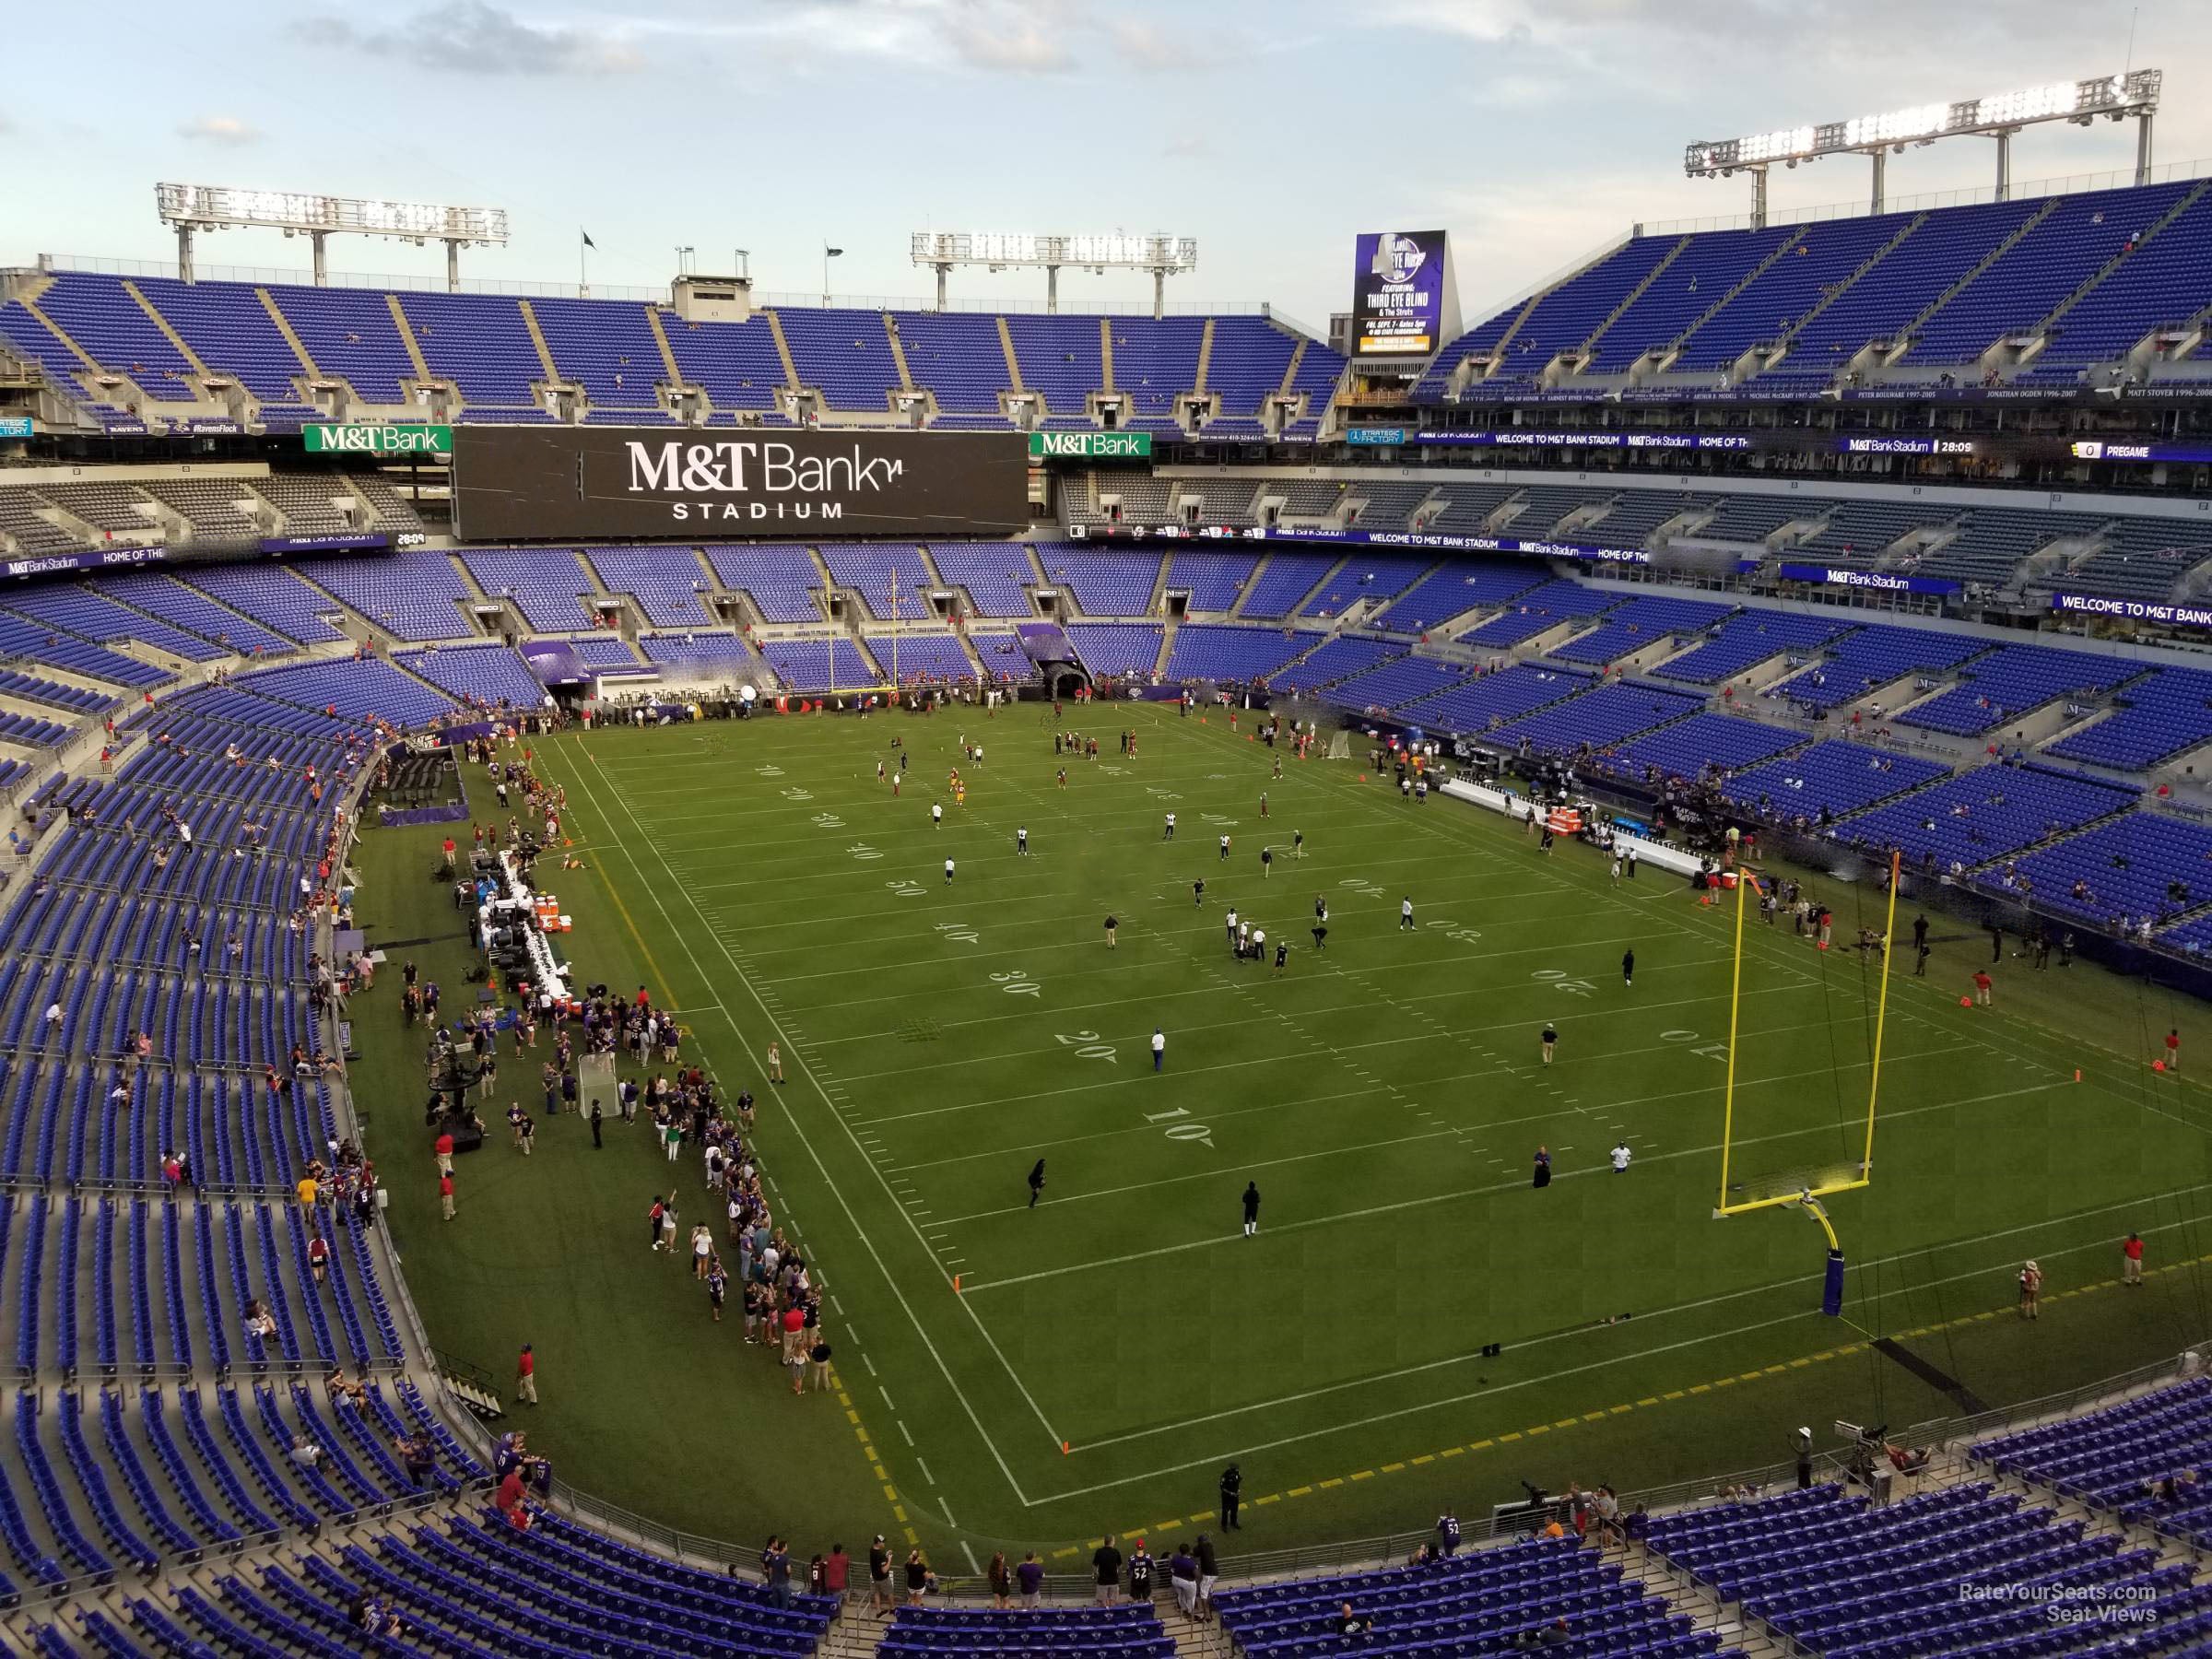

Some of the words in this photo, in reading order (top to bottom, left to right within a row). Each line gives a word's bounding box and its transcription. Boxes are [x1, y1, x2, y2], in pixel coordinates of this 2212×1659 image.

[1367, 294, 1389, 309] THIRD
[1391, 293, 1404, 308] EYE
[1406, 292, 1429, 307] BLIND
[1986, 390, 2018, 398] JONATHAN
[193, 424, 238, 434] #RavensFlock
[319, 427, 381, 450] M&T
[383, 427, 439, 450] Bank
[1041, 434, 1092, 454] M&T
[1093, 434, 1139, 454] Bank
[1495, 434, 1534, 443] WELCOME
[1535, 435, 1547, 443] TO
[1547, 435, 1565, 443] M&T
[1566, 435, 1587, 444] BANK
[1588, 435, 1619, 444] STADIUM
[1628, 436, 1645, 445] M&T
[1645, 436, 1662, 445] Bank
[1663, 436, 1690, 446] Stadium
[1699, 438, 1723, 446] HOME
[1724, 438, 1736, 447] OF
[1850, 440, 1872, 451] M&T
[1872, 440, 1894, 451] Bank
[1893, 441, 1928, 452] Stadium
[1941, 442, 1971, 452] 28:09
[2087, 445, 2094, 456] 0
[2107, 446, 2149, 457] PREGAME
[625, 441, 757, 491] M&T
[764, 443, 880, 491] Bank
[673, 502, 842, 520] STADIUM
[398, 534, 425, 545] 28:09
[1369, 534, 1408, 544] WELCOME
[1411, 535, 1423, 544] TO
[1424, 536, 1441, 545] M&T
[1443, 537, 1464, 547] BANK
[1465, 538, 1499, 548] STADIUM
[103, 550, 130, 563] HOME
[132, 548, 146, 559] OF
[1519, 542, 1536, 552] M&T
[1535, 543, 1552, 554] Bank
[1552, 544, 1579, 557] Stadium
[1598, 548, 1620, 559] HOME
[1621, 550, 1633, 560] OF
[8, 561, 29, 574] M&T
[29, 560, 48, 572] Bank
[48, 557, 78, 570] Stadium
[1827, 570, 1850, 583] M&T
[1850, 572, 1871, 586] Bank
[1872, 574, 1909, 589] Stadium
[2062, 595, 2124, 614] WELCOME
[2125, 603, 2144, 617] TO
[2146, 606, 2175, 620] M&T
[2176, 609, 2212, 625] BANK
[811, 812, 847, 828] 30
[846, 841, 884, 859] 40
[886, 880, 928, 896] 50
[932, 923, 980, 941] 40
[989, 971, 1041, 994] 30
[1053, 1030, 1117, 1058] 20
[1142, 1107, 1211, 1140] 10
[1448, 1523, 1459, 1535] 52
[1134, 1567, 1147, 1580] 52
